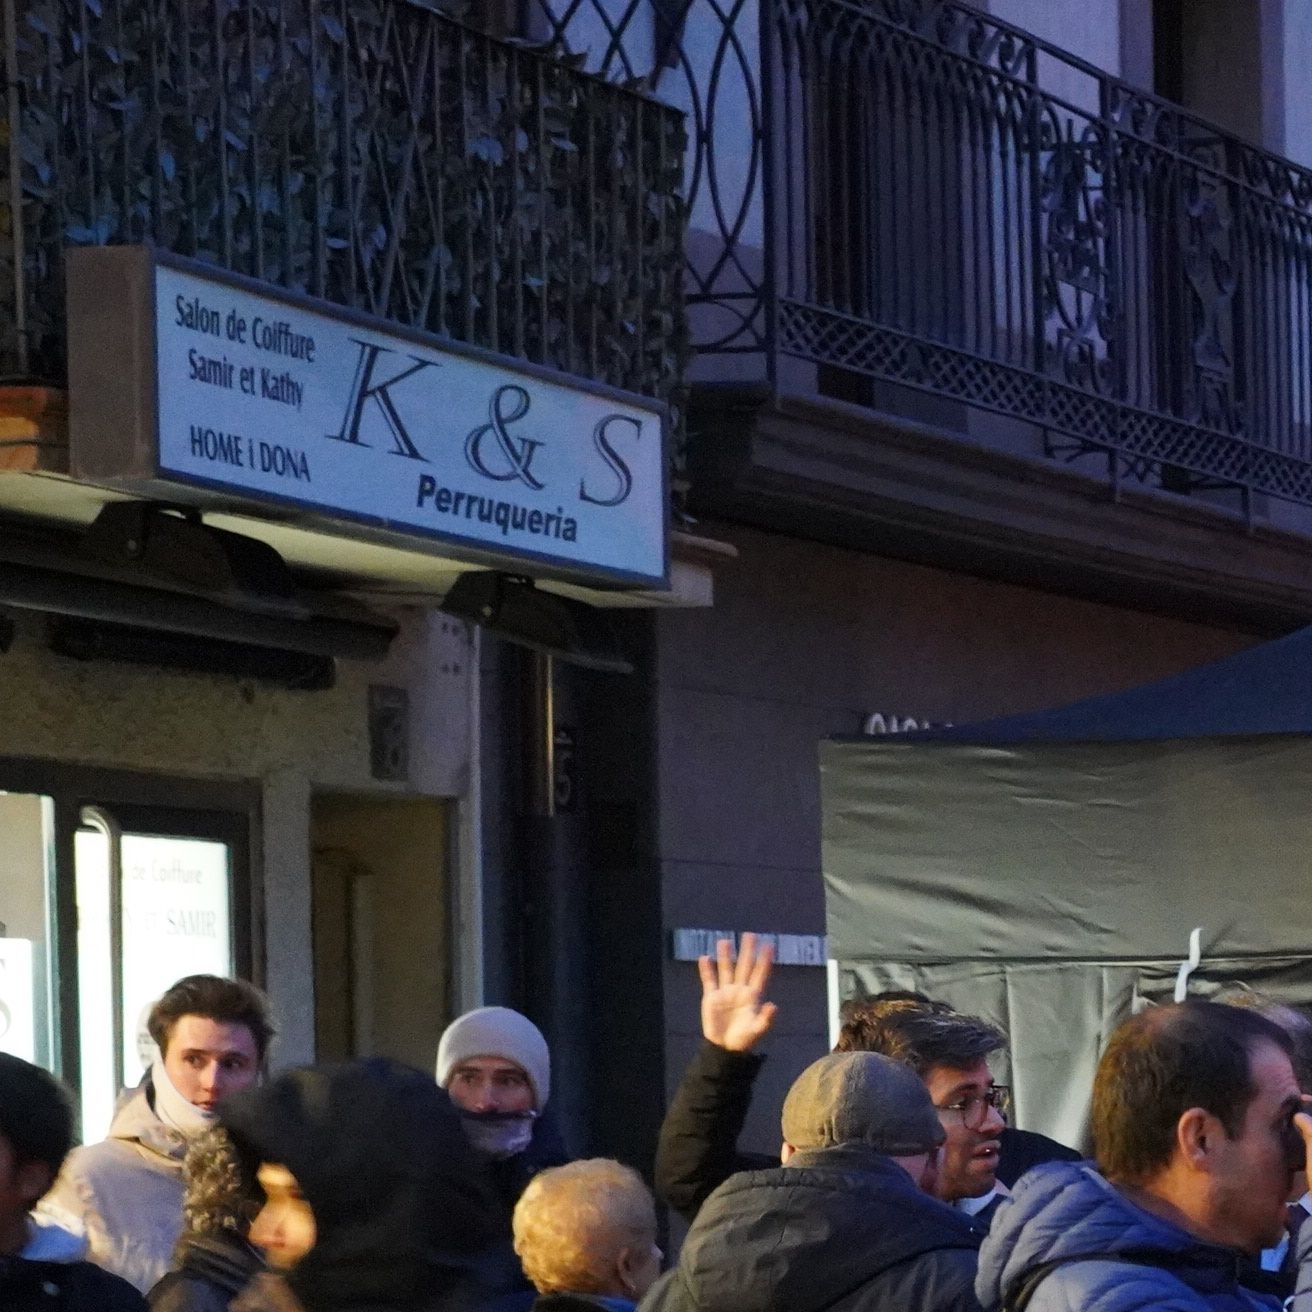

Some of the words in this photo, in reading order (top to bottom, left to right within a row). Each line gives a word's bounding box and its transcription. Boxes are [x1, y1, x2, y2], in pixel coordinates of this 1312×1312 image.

[175, 294, 220, 337] Salon
[226, 308, 247, 344] de
[252, 316, 316, 363] Coiffure
[188, 348, 234, 389] Samir
[239, 367, 256, 395] et
[260, 367, 304, 413] Kathy
[190, 424, 244, 468] HOME
[259, 441, 311, 483] DONA
[325, 337, 443, 464] K
[465, 384, 545, 491] &
[579, 414, 643, 507] S
[416, 473, 578, 543] Perruqueria
